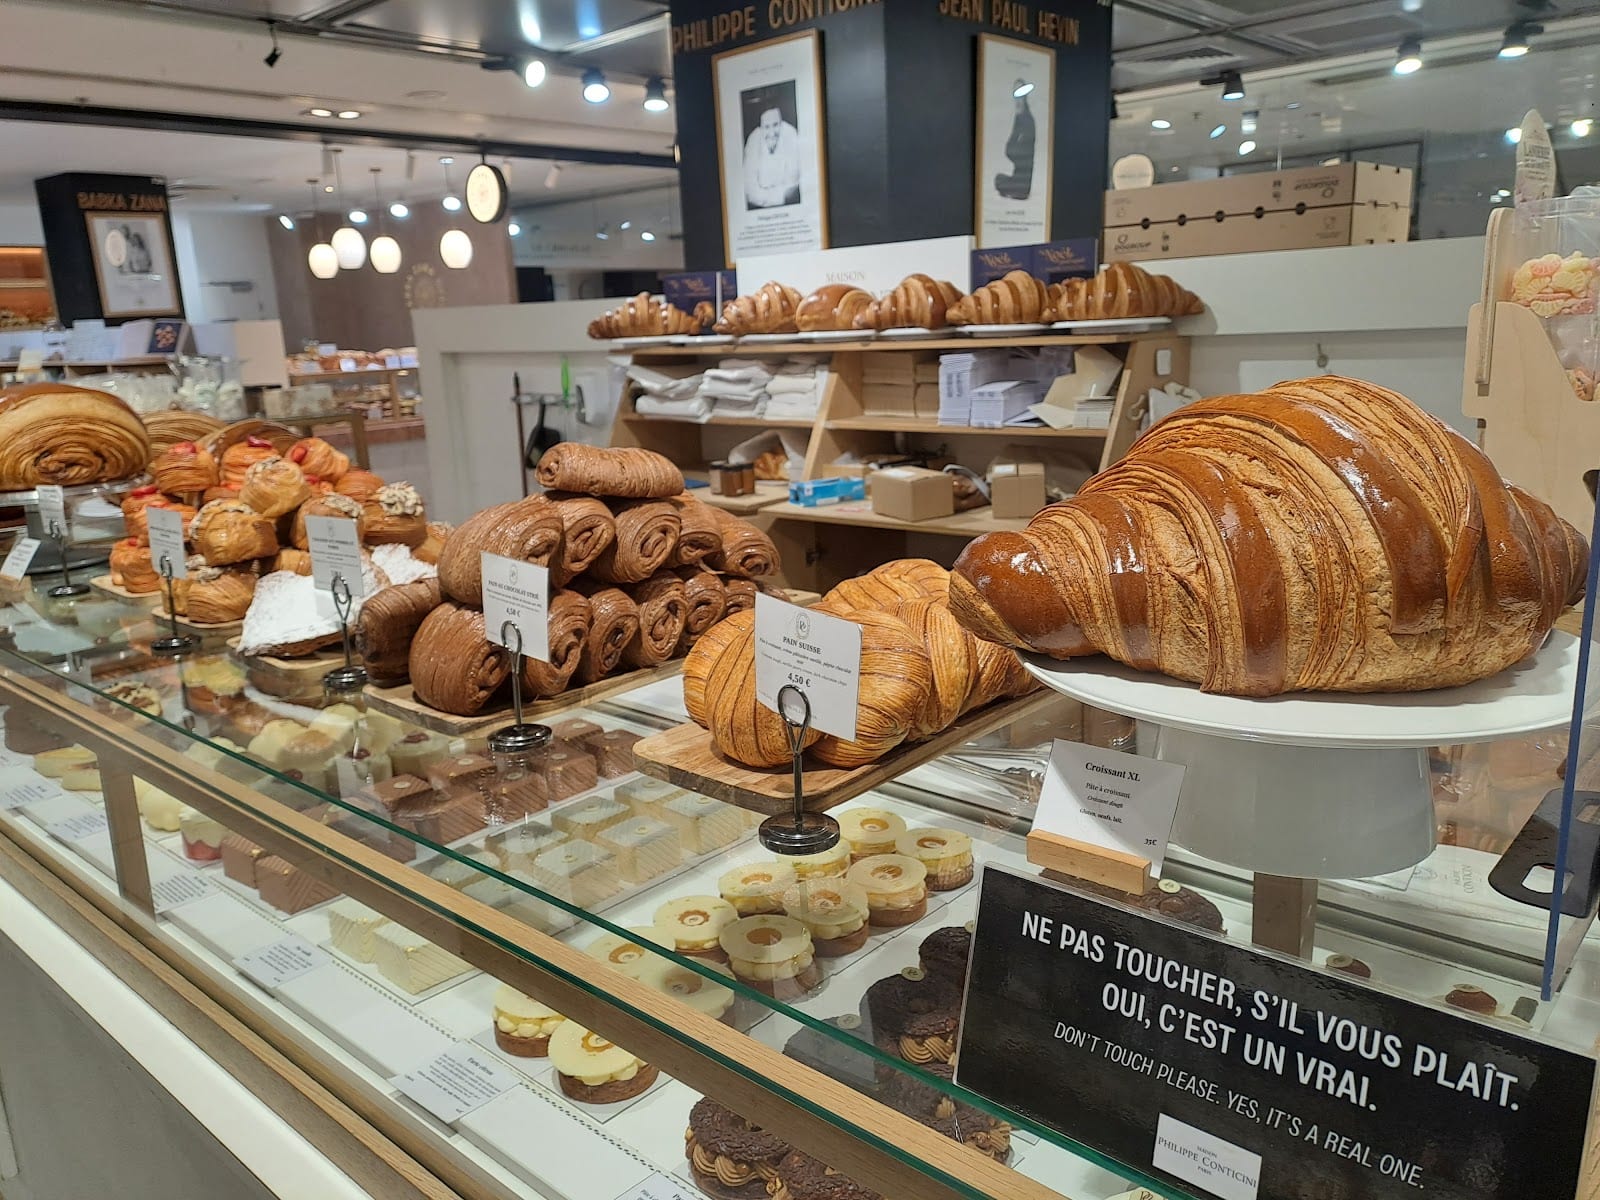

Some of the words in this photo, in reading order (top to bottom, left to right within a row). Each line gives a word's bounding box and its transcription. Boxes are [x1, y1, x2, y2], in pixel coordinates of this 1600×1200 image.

[938, 0, 984, 23] JEAN
[992, 0, 1030, 34] PAUL
[673, 6, 756, 54] PHILIPPE
[825, 271, 865, 282] MAISON
[782, 636, 798, 647] PAIN
[798, 641, 822, 655] SUISSE
[787, 672, 804, 685] 4,50
[805, 678, 812, 688] €
[1085, 762, 1127, 779] Croissant
[1127, 771, 1141, 782] XL
[1085, 782, 1099, 792] Pâte
[1104, 787, 1131, 799] croissant
[1021, 911, 1053, 945] NE
[1059, 924, 1106, 963] PAS
[1113, 941, 1243, 1017] TOUCHER,
[1250, 990, 1304, 1035] S'IL
[1316, 1010, 1402, 1069] VOUS
[1412, 1044, 1520, 1112] PLAÎT.
[1101, 982, 1151, 1030] OUI,
[1158, 1003, 1236, 1054] C'EST
[1243, 1033, 1286, 1076] UN
[1296, 1052, 1378, 1112] VRAI.
[1054, 1021, 1101, 1053] DON'T
[1103, 1040, 1154, 1076] TOUCH
[1156, 1063, 1220, 1105] PLEASE.
[1227, 1090, 1261, 1124] YES,
[1266, 1107, 1302, 1137] IT'S
[1304, 1124, 1319, 1145] A
[1324, 1131, 1373, 1168] REAL
[1379, 1154, 1424, 1190] ONE.
[1197, 1145, 1218, 1158] MAISON
[1158, 1137, 1199, 1161] PHILIPPE
[1202, 1156, 1257, 1188] CONTICINI
[1197, 1165, 1212, 1176] PARIS
